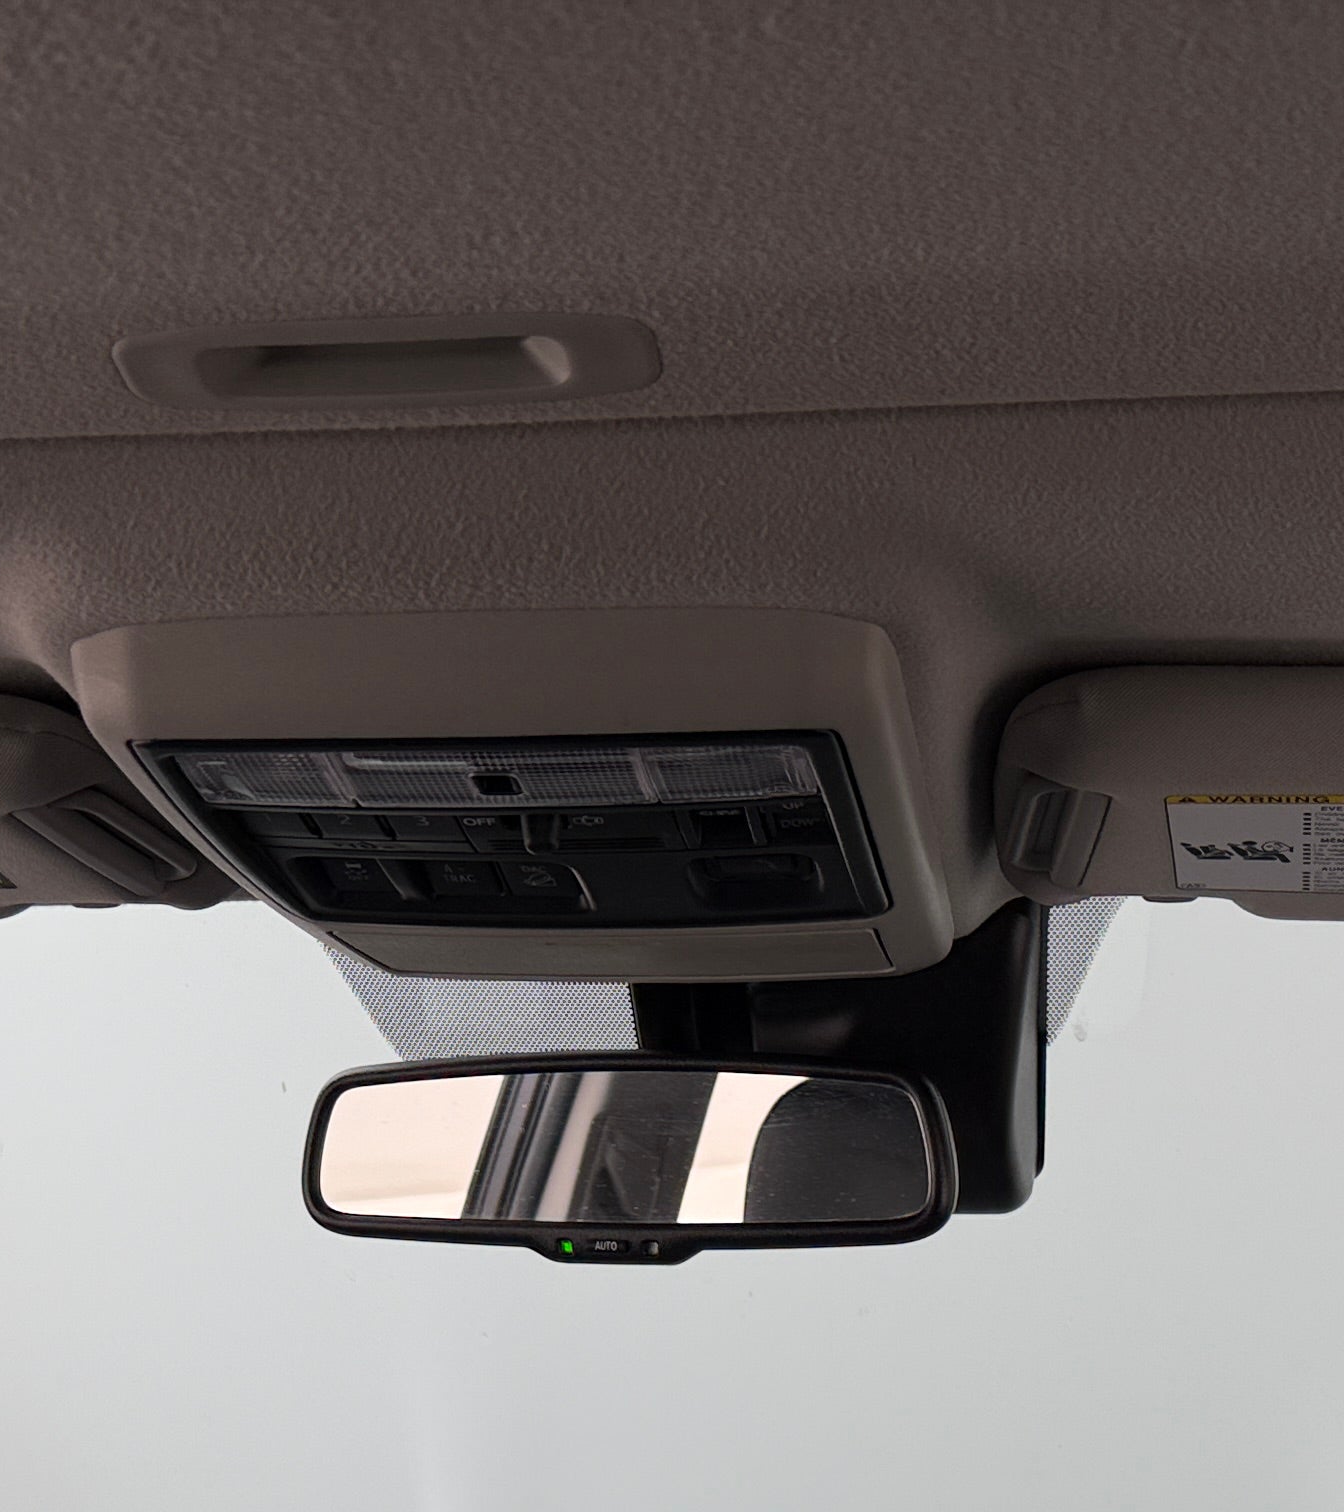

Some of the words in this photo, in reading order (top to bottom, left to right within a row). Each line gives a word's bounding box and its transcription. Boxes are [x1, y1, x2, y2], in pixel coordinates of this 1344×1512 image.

[1208, 795, 1330, 804] WARNING
[462, 817, 496, 826] OFF
[594, 1241, 618, 1251] AUTO
